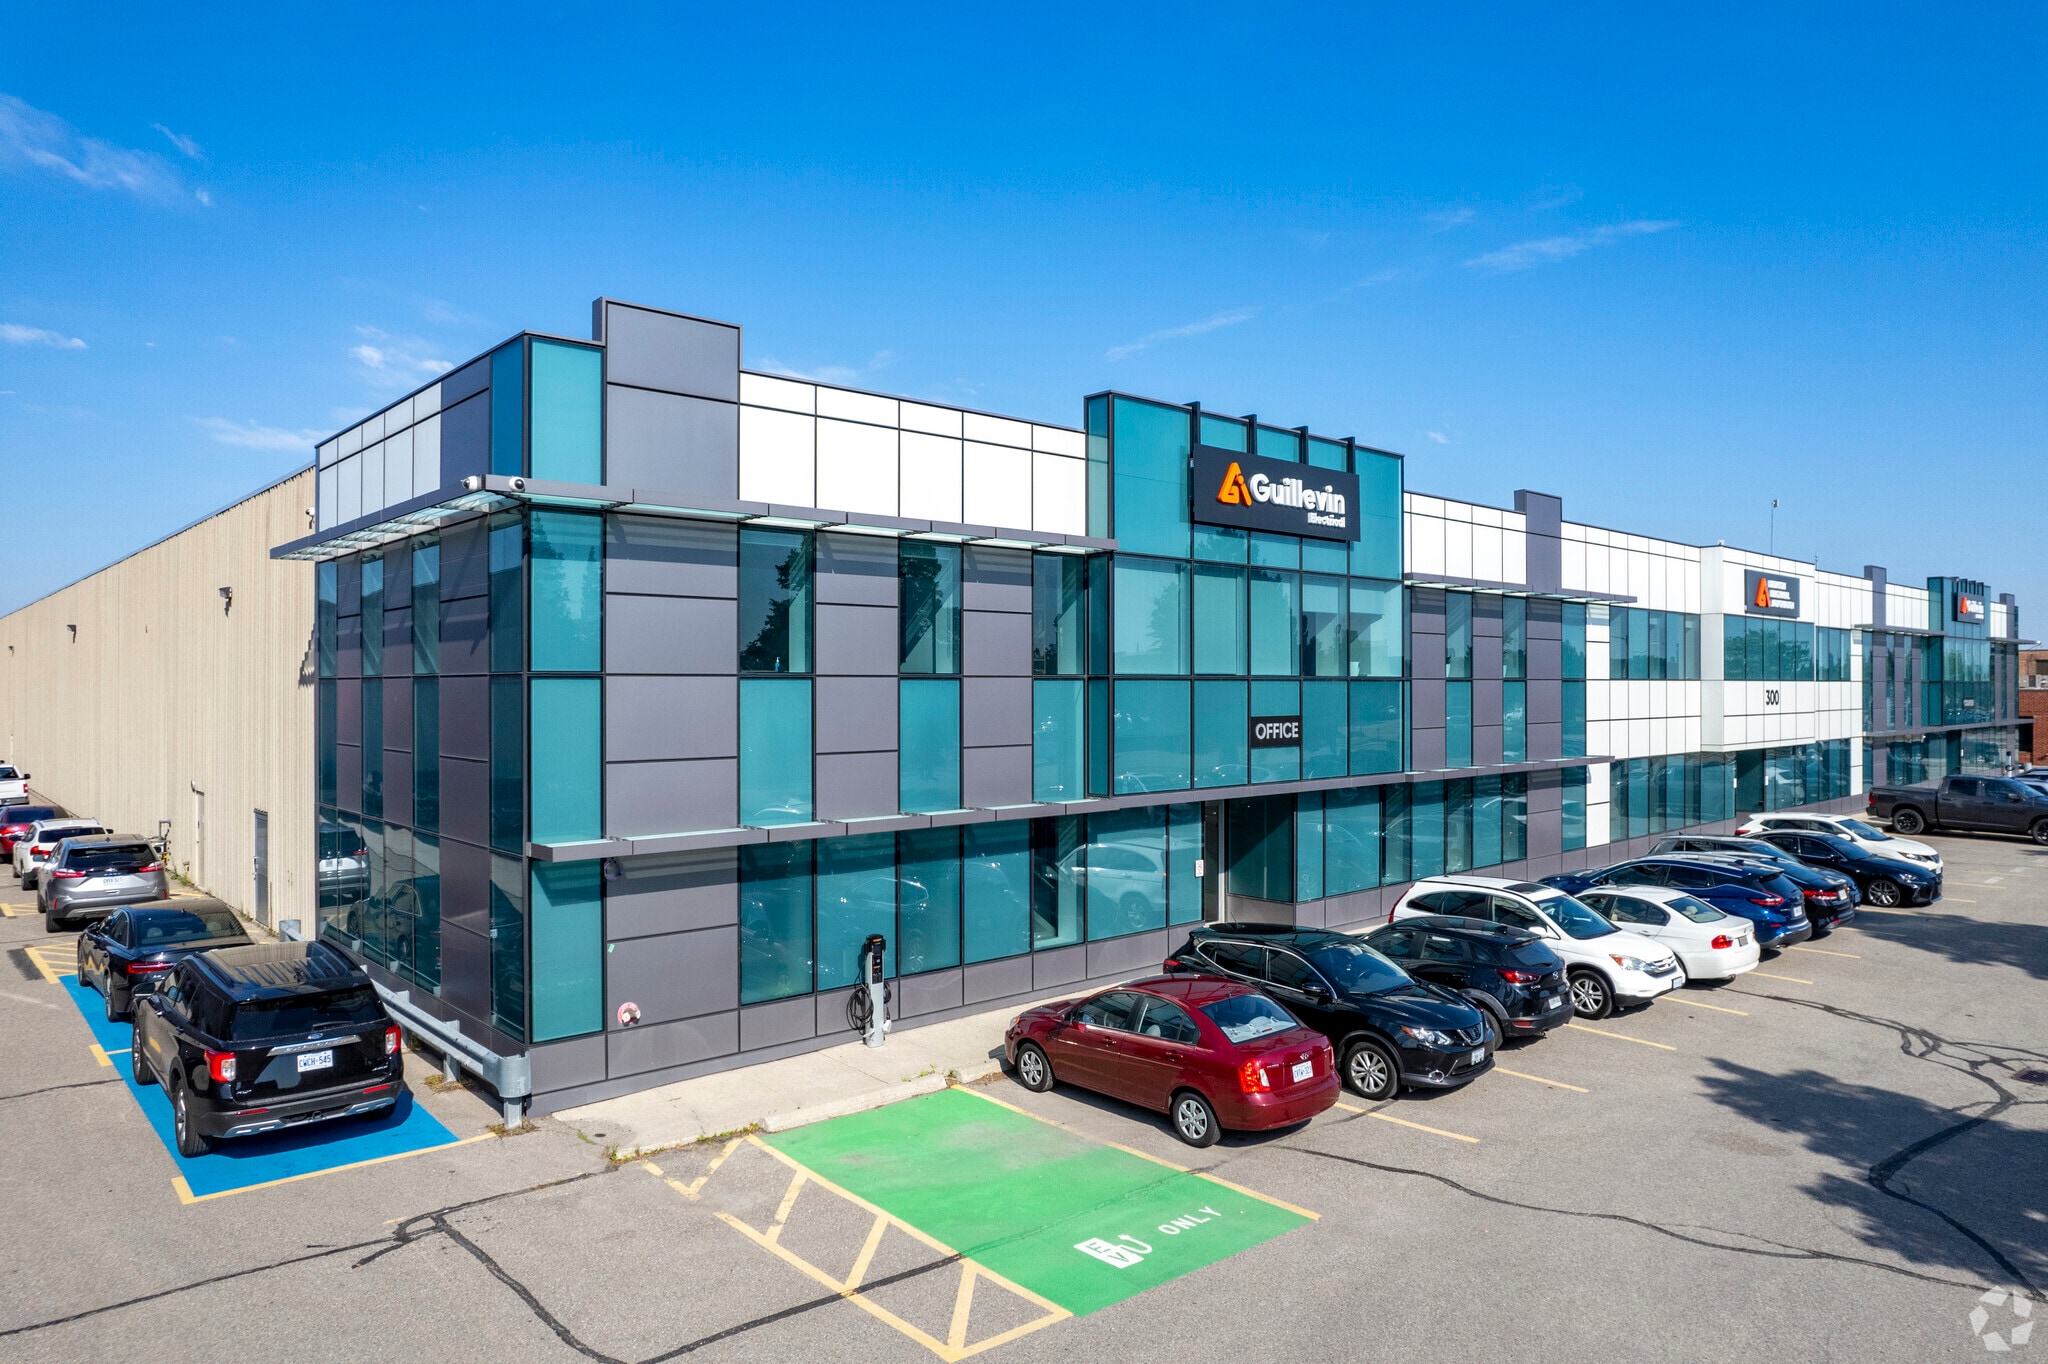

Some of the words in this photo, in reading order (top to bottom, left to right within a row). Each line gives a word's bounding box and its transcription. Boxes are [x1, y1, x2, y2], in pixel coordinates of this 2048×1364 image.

[1250, 473, 1345, 514] Guillevin
[1765, 689, 1780, 706] 300
[1255, 722, 1299, 740] OFFICE
[1158, 1206, 1222, 1235] ONLY
